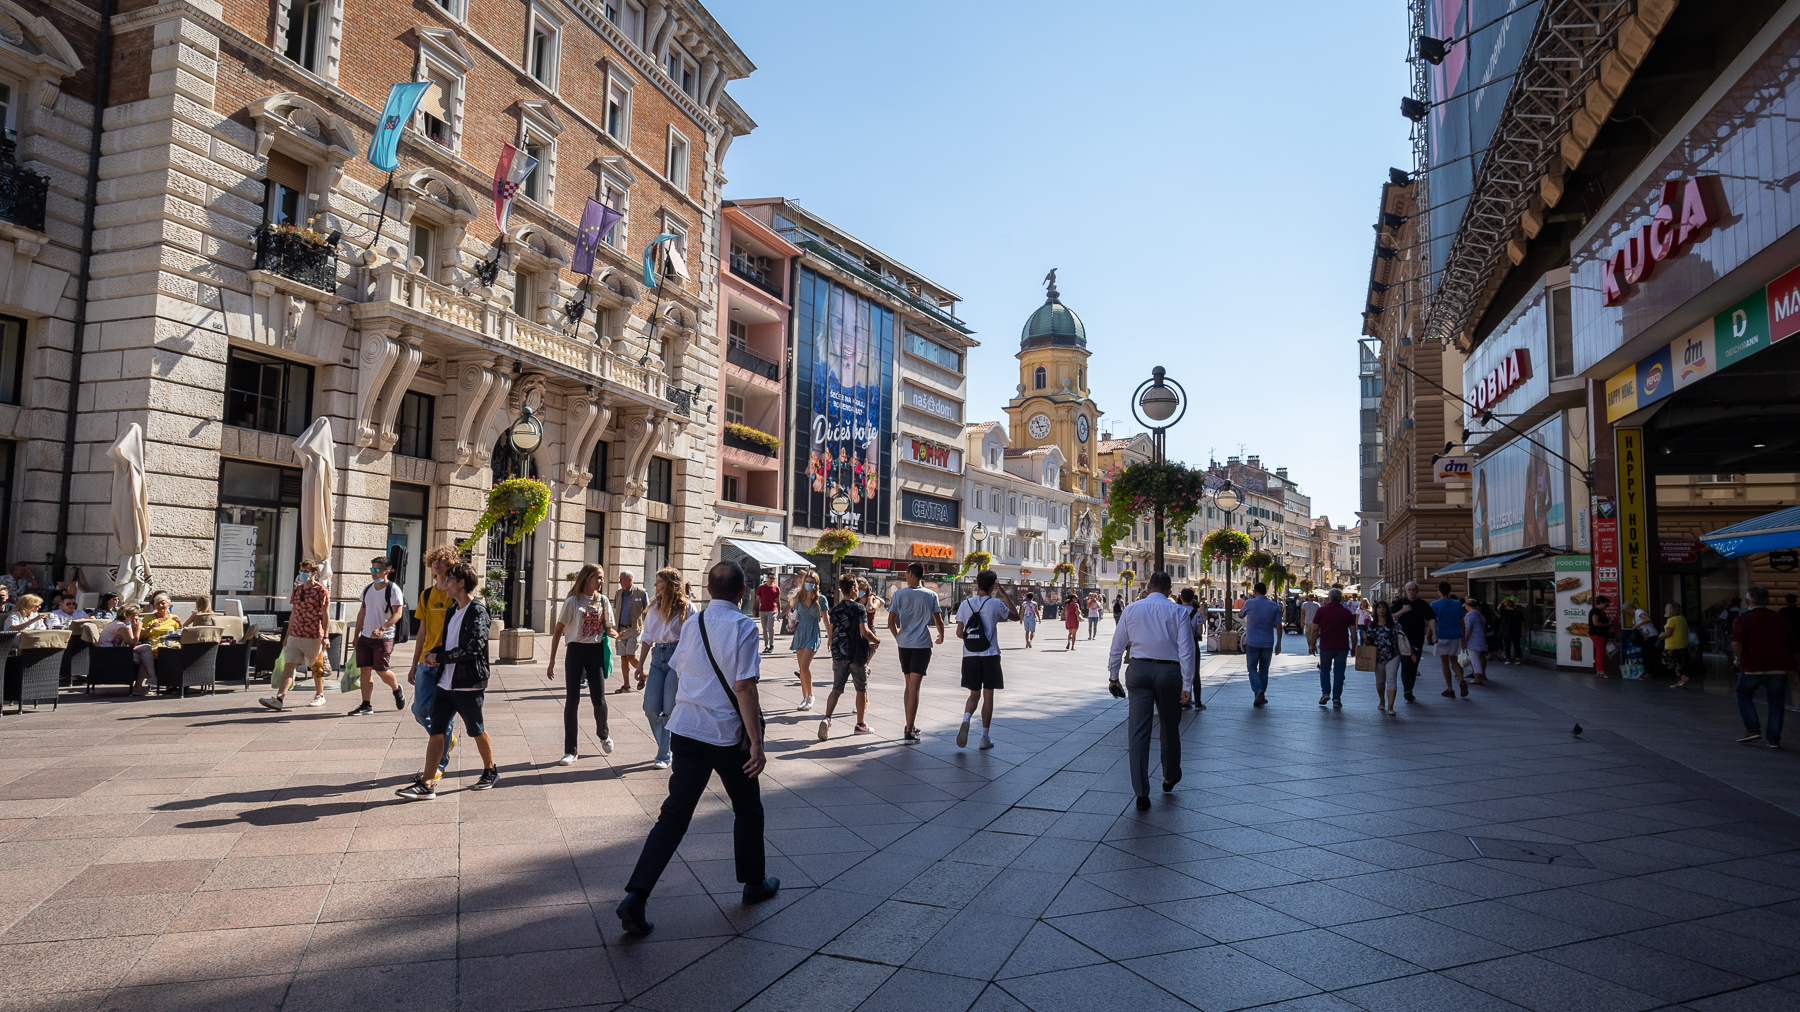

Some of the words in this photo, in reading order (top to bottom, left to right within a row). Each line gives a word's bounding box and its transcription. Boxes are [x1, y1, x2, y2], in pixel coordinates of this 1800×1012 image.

[1602, 176, 1713, 307] KUĆA
[1732, 308, 1748, 338] D
[1684, 338, 1703, 366] dm
[1724, 334, 1759, 358] DEICHMANN
[1469, 348, 1531, 418] ROBNA
[1646, 372, 1661, 387] PEPCO
[912, 393, 928, 408] naš
[935, 399, 952, 418] dom
[1607, 387, 1621, 407] HAPPY
[911, 440, 951, 468] TOMMY
[1444, 459, 1468, 472] dm
[1624, 435, 1635, 505] HAPPY
[911, 499, 949, 523] CENTRA
[911, 543, 955, 559] KORZO
[1628, 513, 1639, 570] HOME
[871, 558, 892, 568] TOMMY
[1563, 609, 1587, 617] Snack
